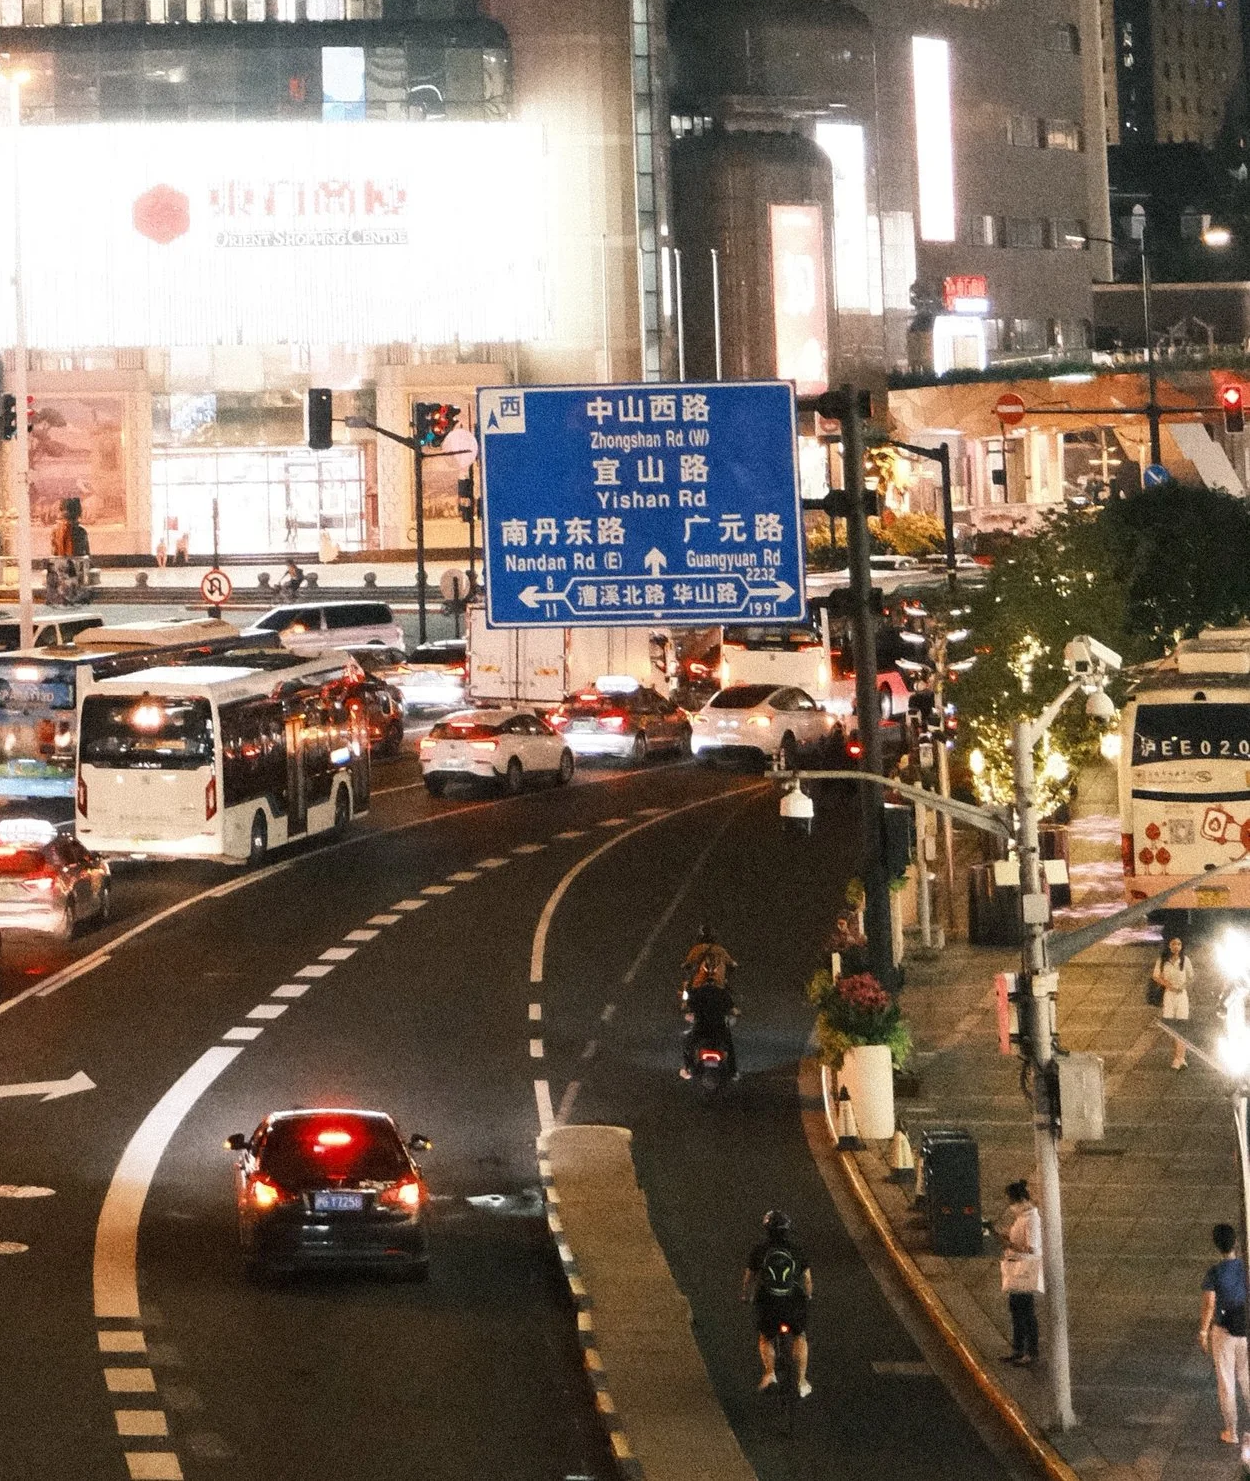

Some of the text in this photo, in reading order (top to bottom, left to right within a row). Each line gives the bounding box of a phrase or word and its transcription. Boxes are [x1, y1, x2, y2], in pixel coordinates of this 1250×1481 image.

[499, 396, 520, 417] 西
[587, 393, 710, 426] 中山西路
[590, 428, 710, 453] Zhongshan Rd (W)
[592, 453, 709, 485] 宜山路
[597, 489, 707, 509] Yishan Rd
[501, 517, 625, 546] 南丹东路
[683, 512, 784, 544] 广元路
[505, 551, 623, 572] Nandan Rd (E)
[686, 548, 781, 572] Guangyuan Rd
[746, 567, 776, 582] 2232
[672, 582, 738, 605] 华山路
[545, 603, 558, 618] 11
[749, 602, 777, 617] 1991
